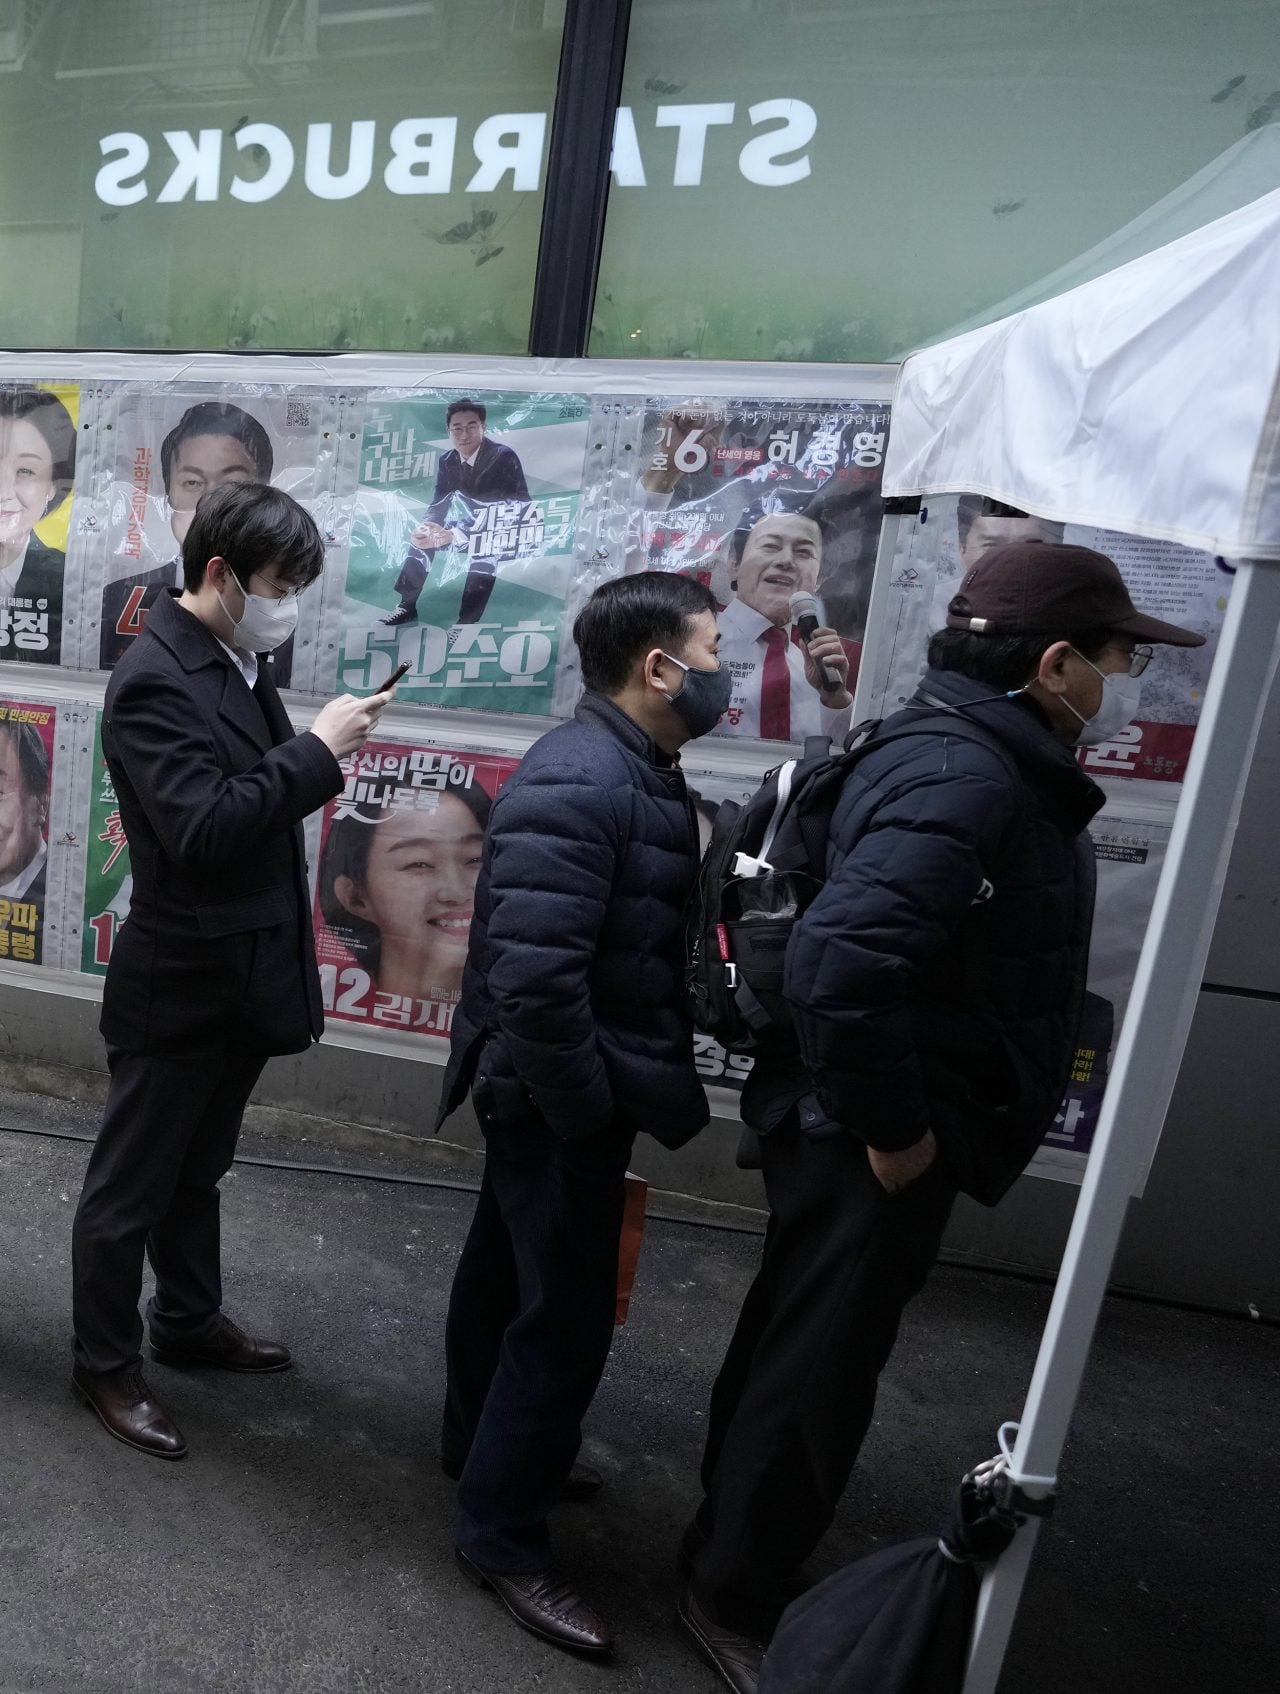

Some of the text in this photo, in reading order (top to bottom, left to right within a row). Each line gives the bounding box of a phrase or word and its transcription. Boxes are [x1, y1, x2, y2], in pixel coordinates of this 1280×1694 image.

[365, 451, 436, 483] 나답게
[674, 429, 708, 474] 6
[716, 448, 762, 461] 난세의 영웅
[9, 708, 51, 726] 민생안정
[318, 962, 371, 1018] 12
